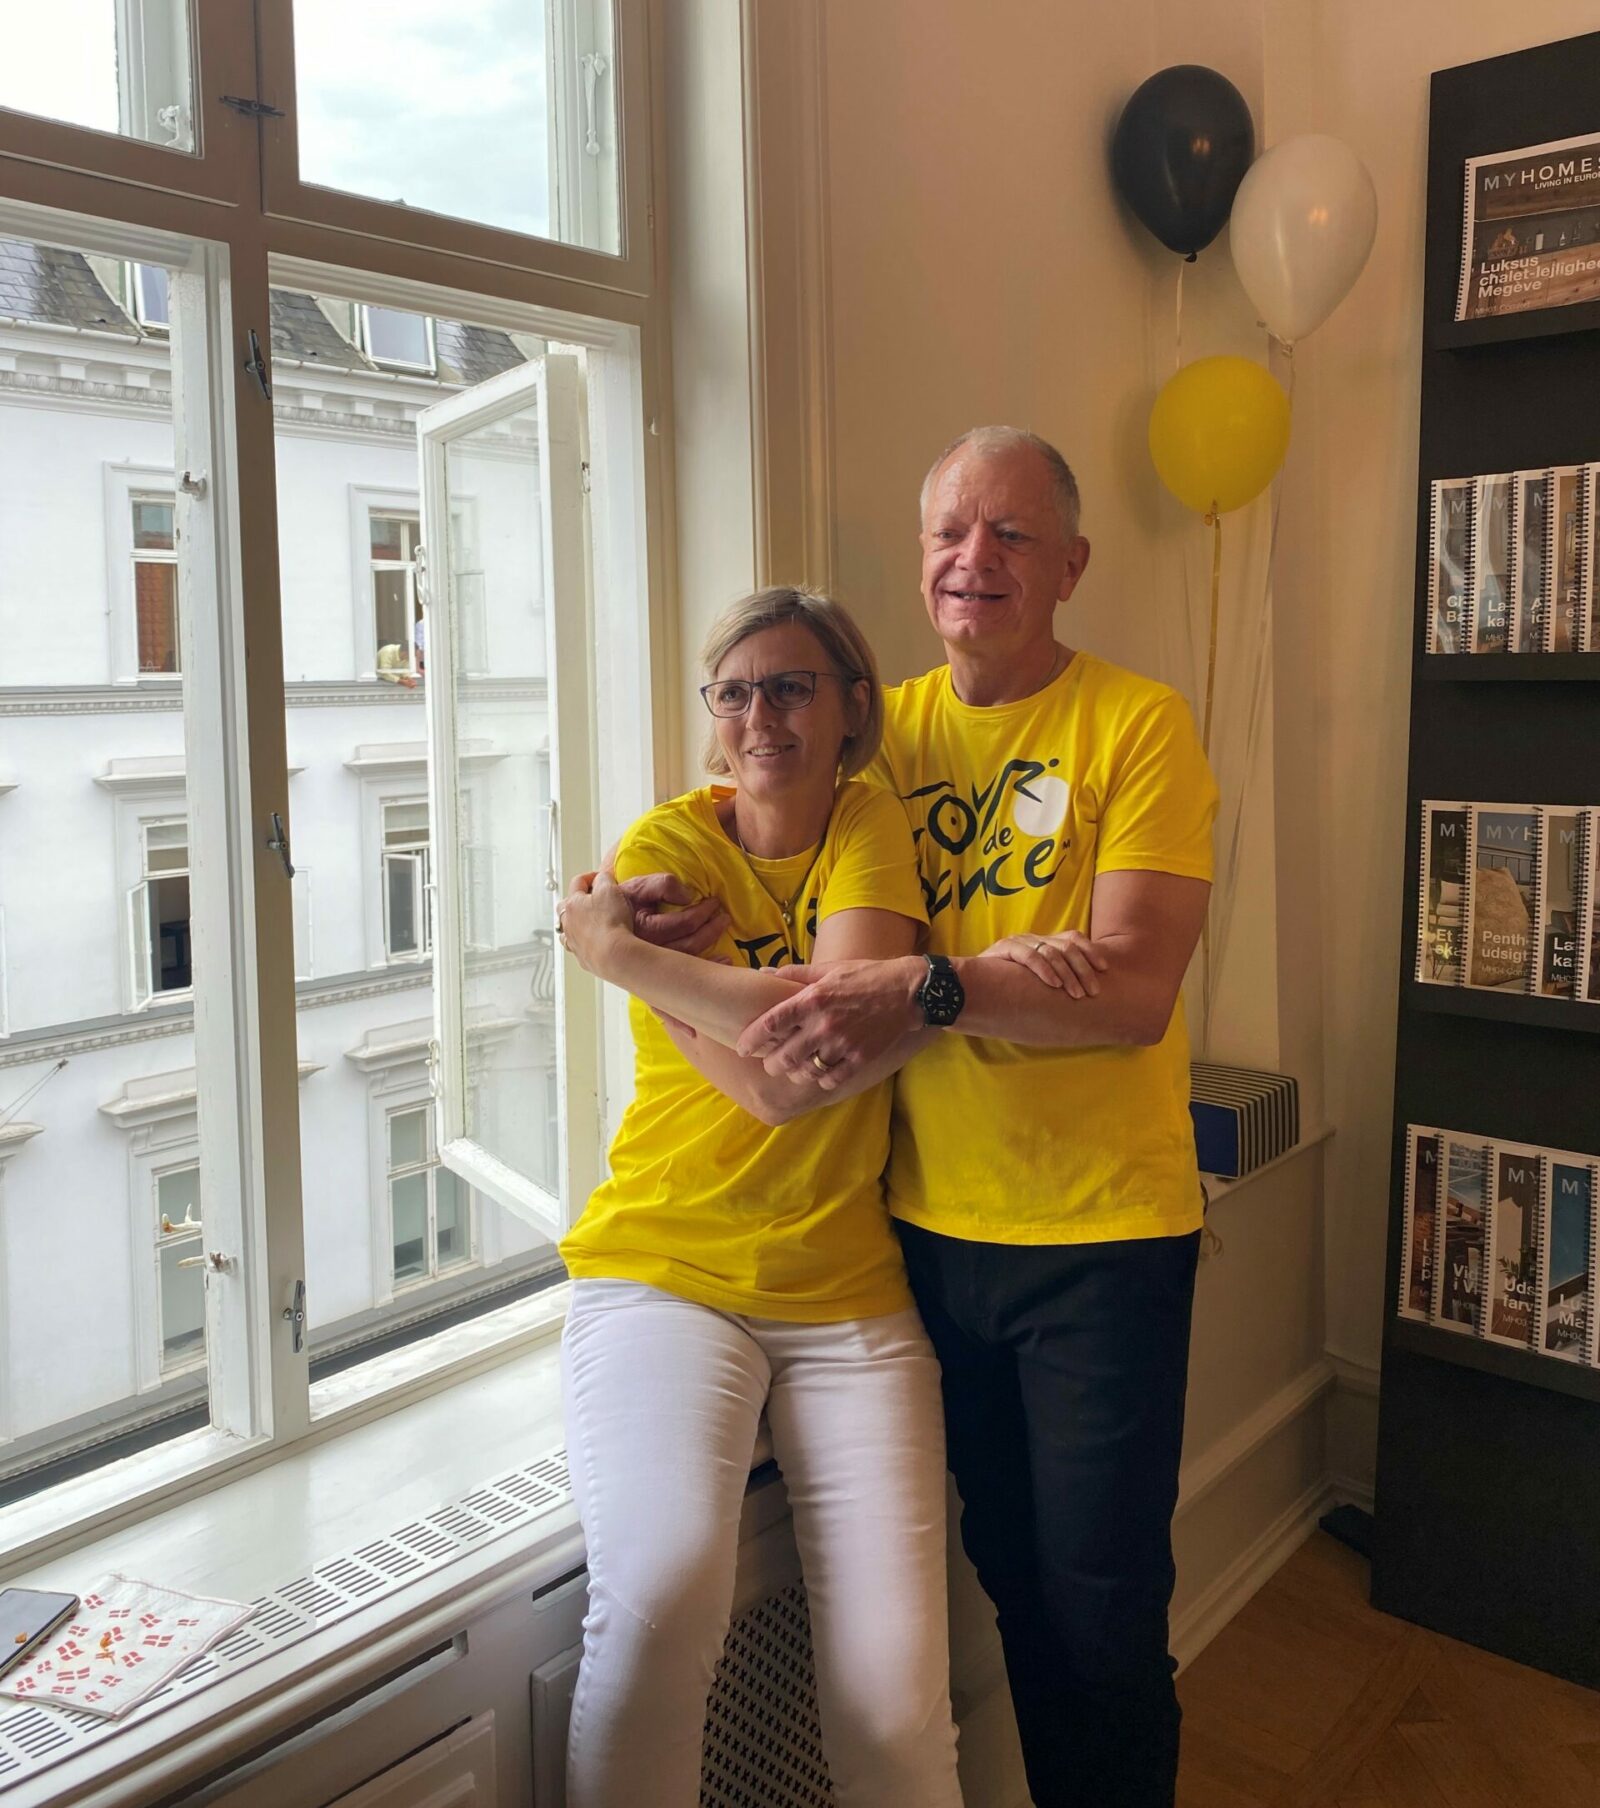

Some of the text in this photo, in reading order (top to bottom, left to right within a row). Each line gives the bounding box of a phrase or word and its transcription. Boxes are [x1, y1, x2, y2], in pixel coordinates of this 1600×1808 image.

[1484, 156, 1600, 191] MYHOME
[1535, 179, 1561, 190] LIVING
[1564, 177, 1572, 185] IN
[1481, 256, 1539, 275] Luksus
[1478, 281, 1543, 299] Megève
[982, 818, 1014, 856] de
[919, 838, 1066, 919] ance
[1482, 930, 1528, 947] Penth
